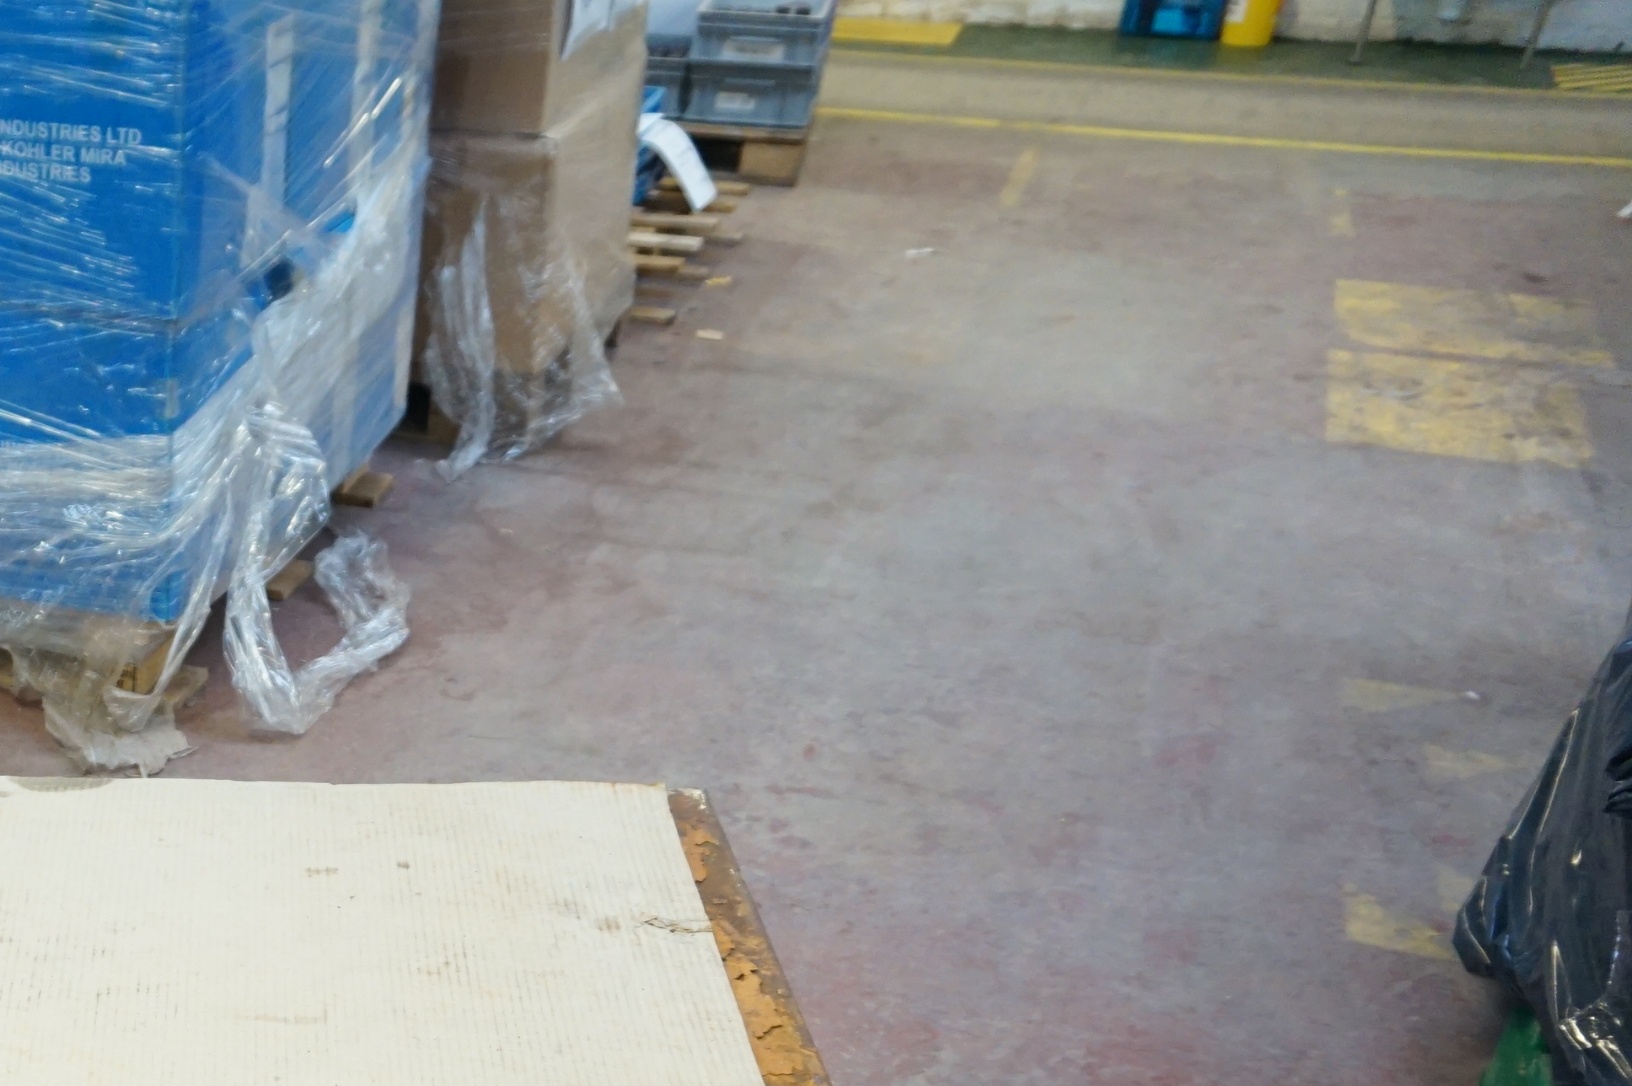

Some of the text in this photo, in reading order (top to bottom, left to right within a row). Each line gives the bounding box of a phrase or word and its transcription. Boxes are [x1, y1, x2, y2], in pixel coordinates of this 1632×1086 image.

[106, 126, 143, 145] LTD
[1, 141, 76, 163] KOHLER
[80, 146, 127, 166] MIRA
